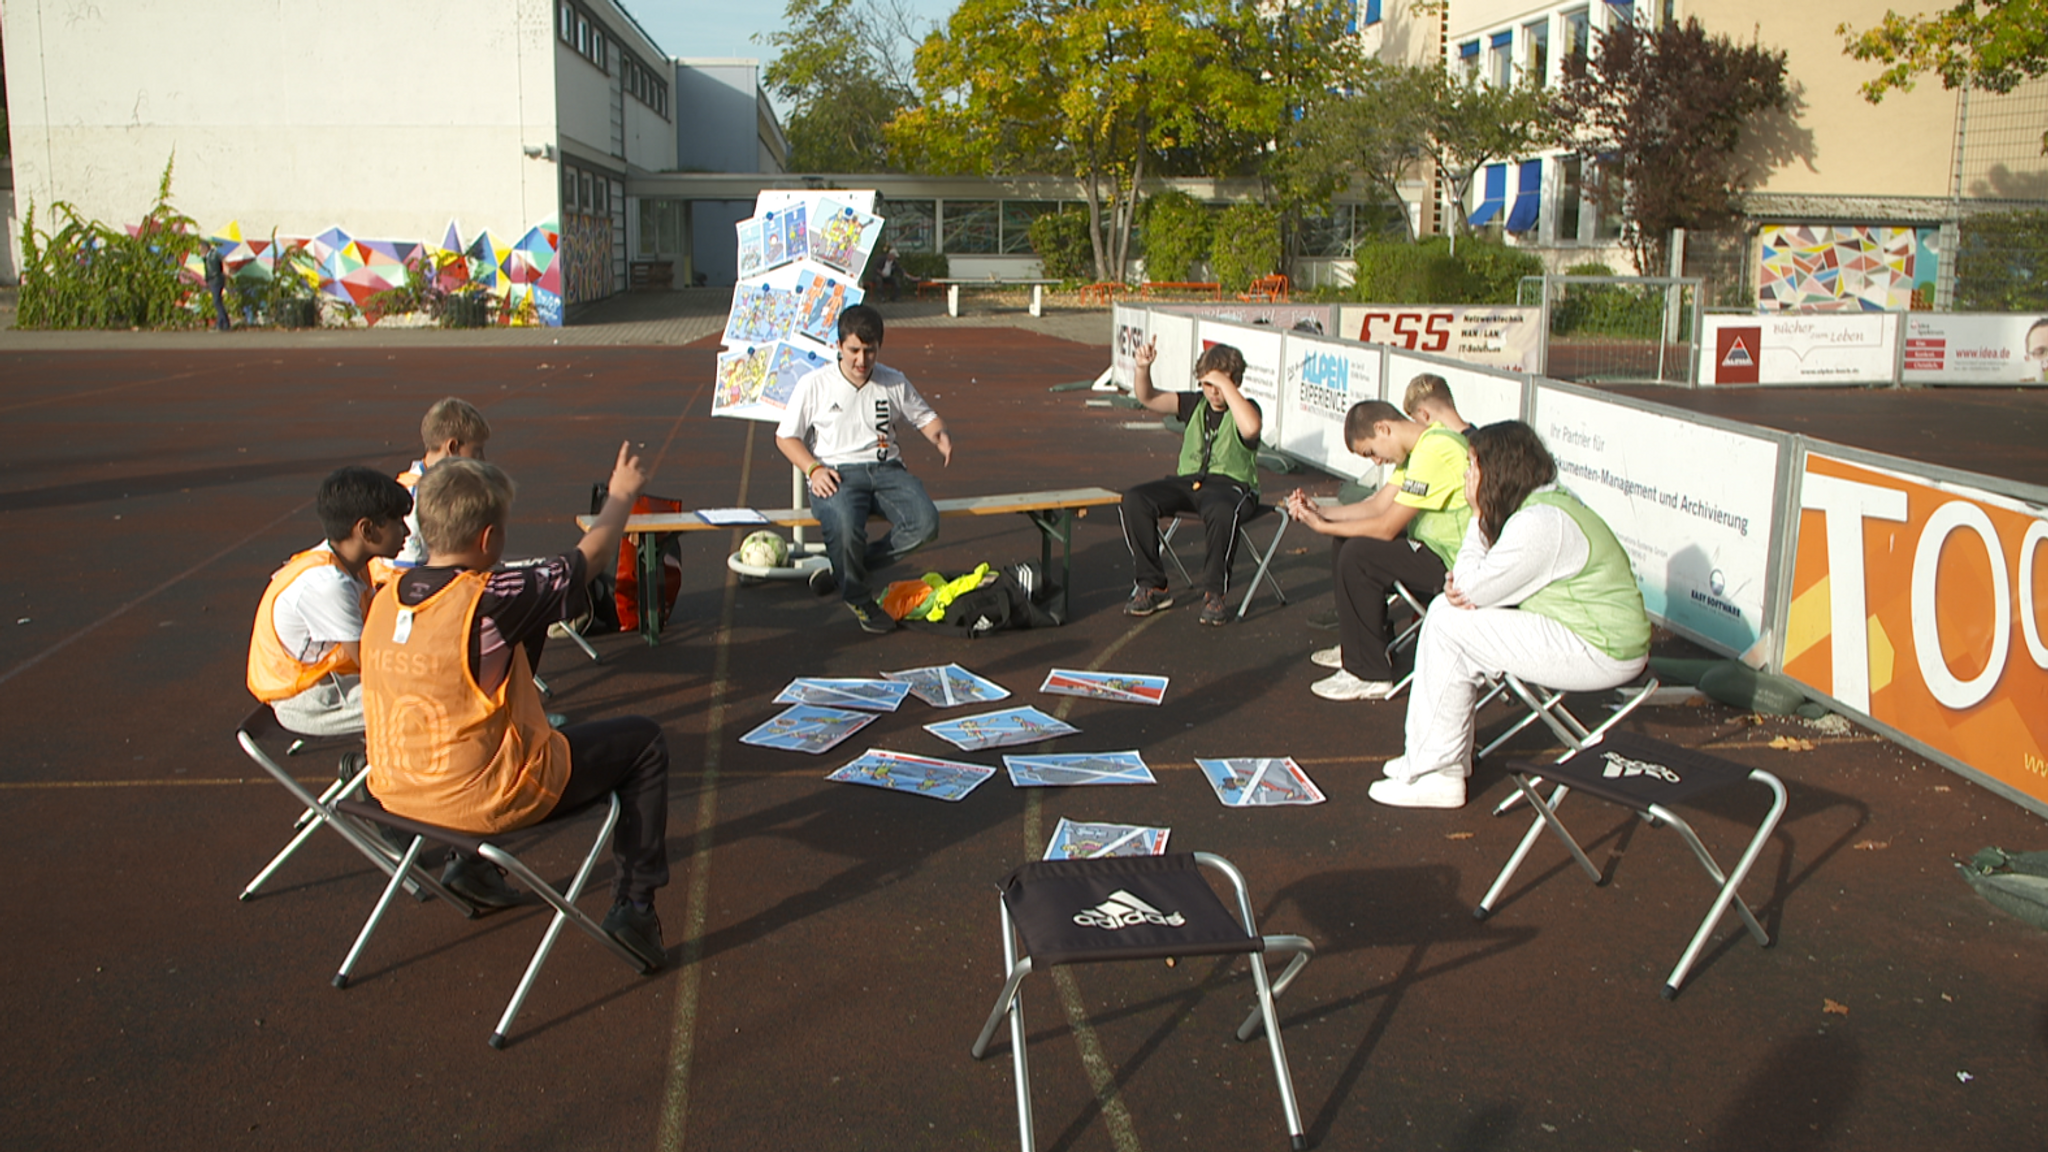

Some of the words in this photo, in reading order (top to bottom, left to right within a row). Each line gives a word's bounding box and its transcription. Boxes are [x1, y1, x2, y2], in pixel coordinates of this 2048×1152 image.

[1359, 313, 1454, 351] CSS
[1463, 314, 1524, 324] Netzwerktechnik
[1484, 329, 1500, 338] LAN
[1956, 347, 2010, 359] www.idea.de
[1302, 350, 1349, 391] ALPEN
[1300, 382, 1348, 413] EXPERIENCE
[1550, 422, 1561, 437] Ihr
[1593, 433, 1605, 452] für
[1554, 454, 1658, 501] okumenten-Management
[1659, 489, 1678, 509] und
[1680, 494, 1749, 536] Archivierung
[1691, 589, 1706, 603] EASY
[1707, 596, 1741, 618] SOFTWARE
[366, 648, 439, 675] MESSI
[1072, 908, 1187, 931] adidas
